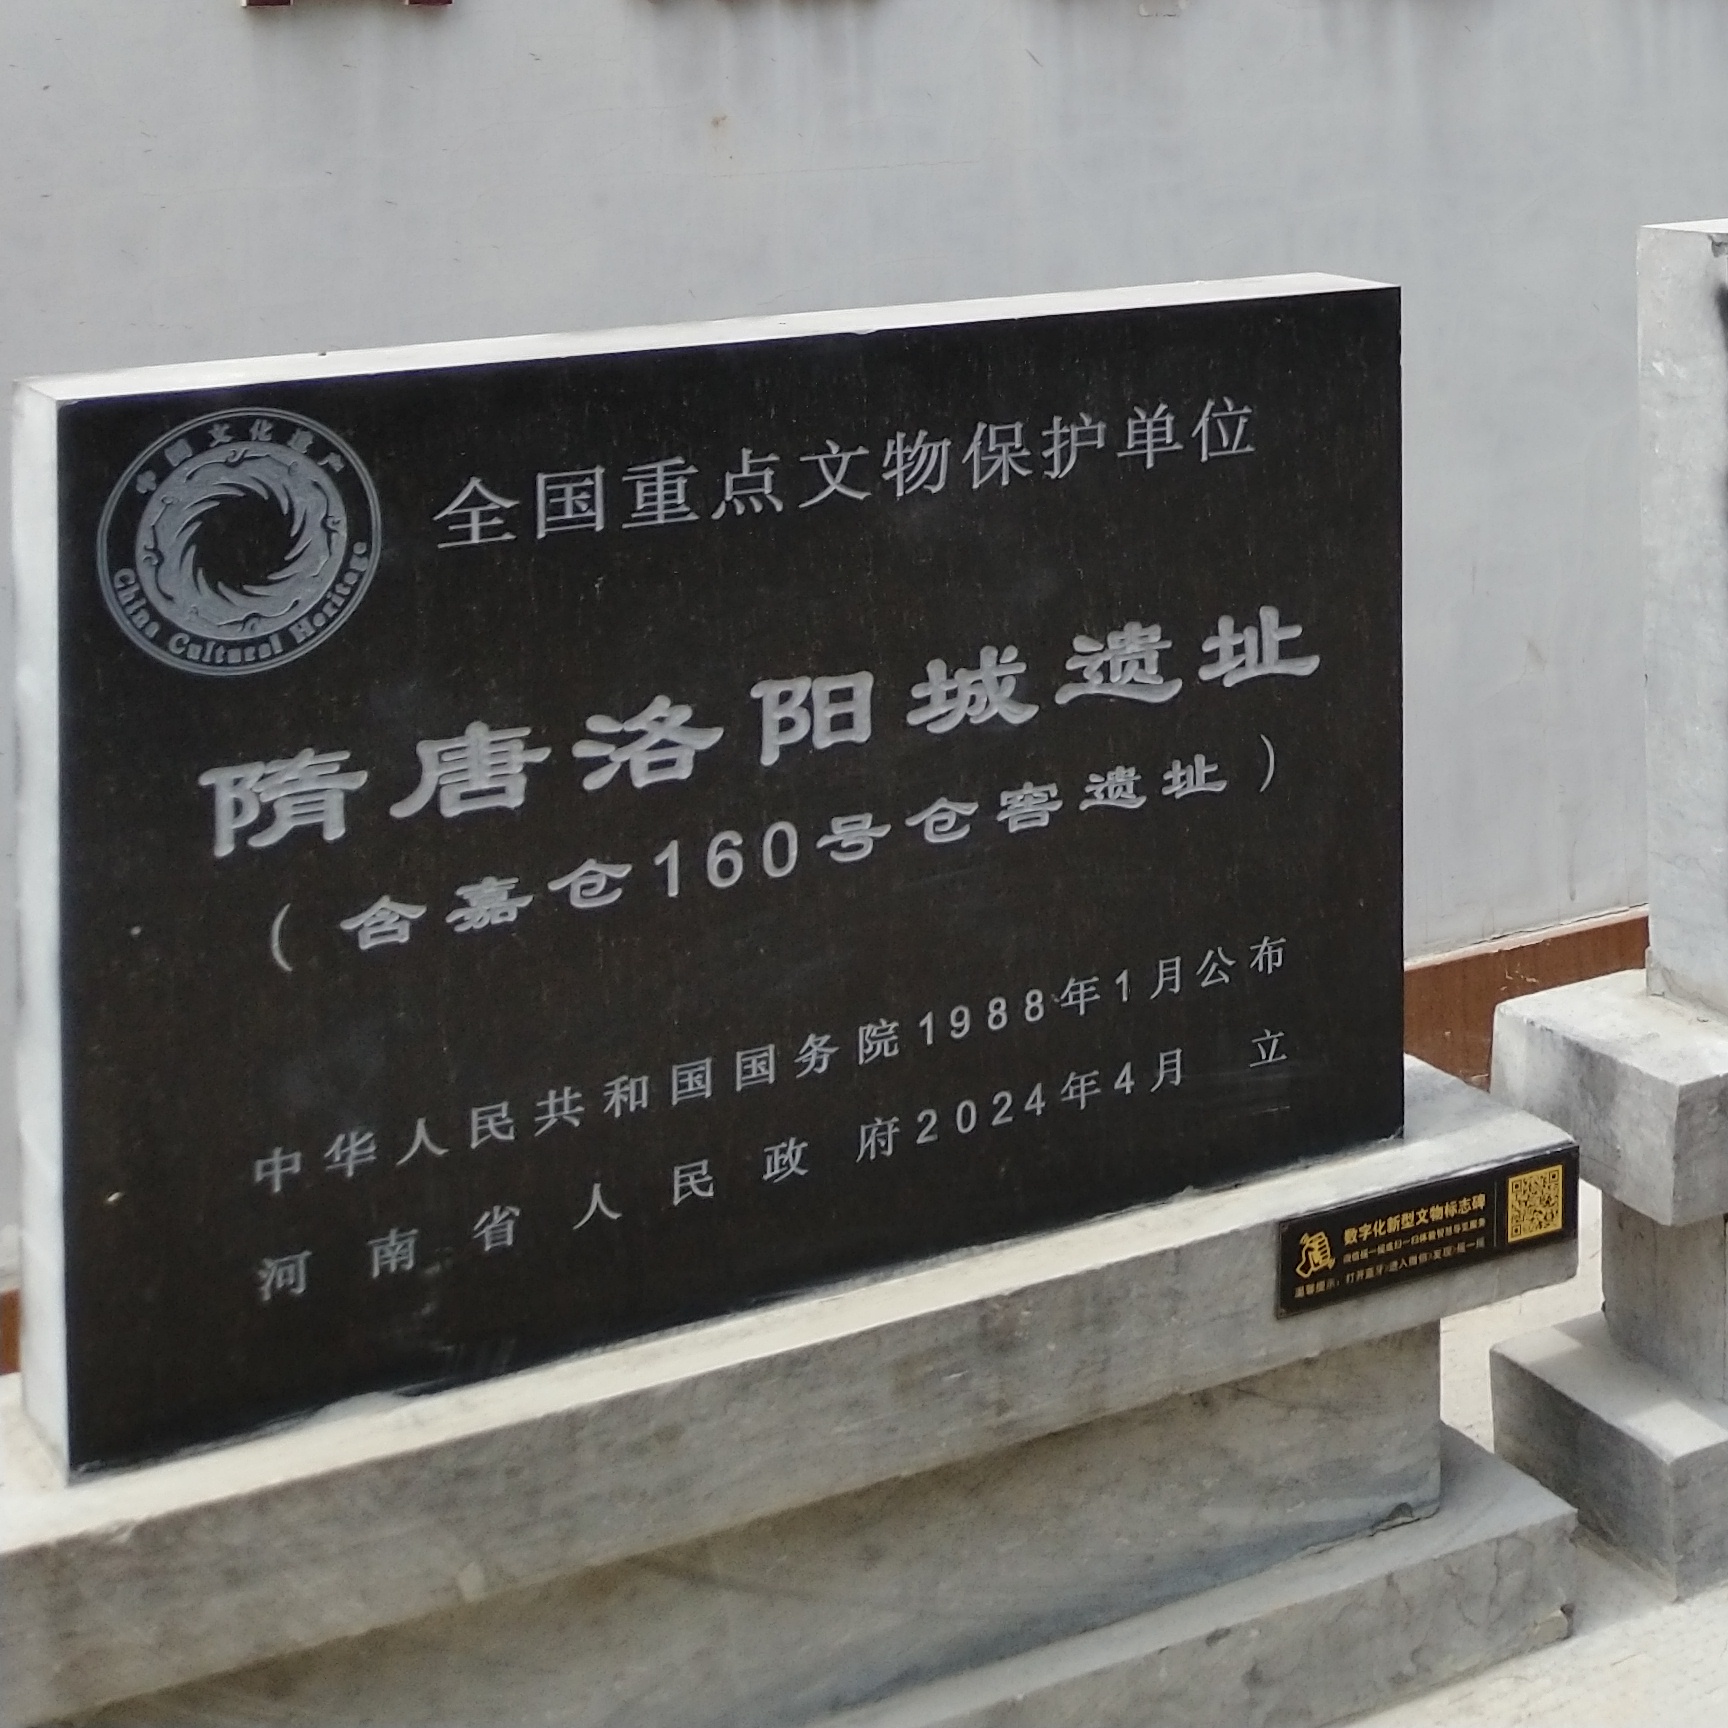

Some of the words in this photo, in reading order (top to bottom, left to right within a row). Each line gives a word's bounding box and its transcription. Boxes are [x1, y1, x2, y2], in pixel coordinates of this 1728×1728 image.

[433, 396, 1256, 549] 全国重点文物保护单位
[198, 604, 1321, 858] 隋唐洛阳城遗址
[254, 936, 1287, 1194] 中华人民共和国国务院1988年1月公布
[1343, 1193, 1487, 1246] 数字化新型文物标志碑
